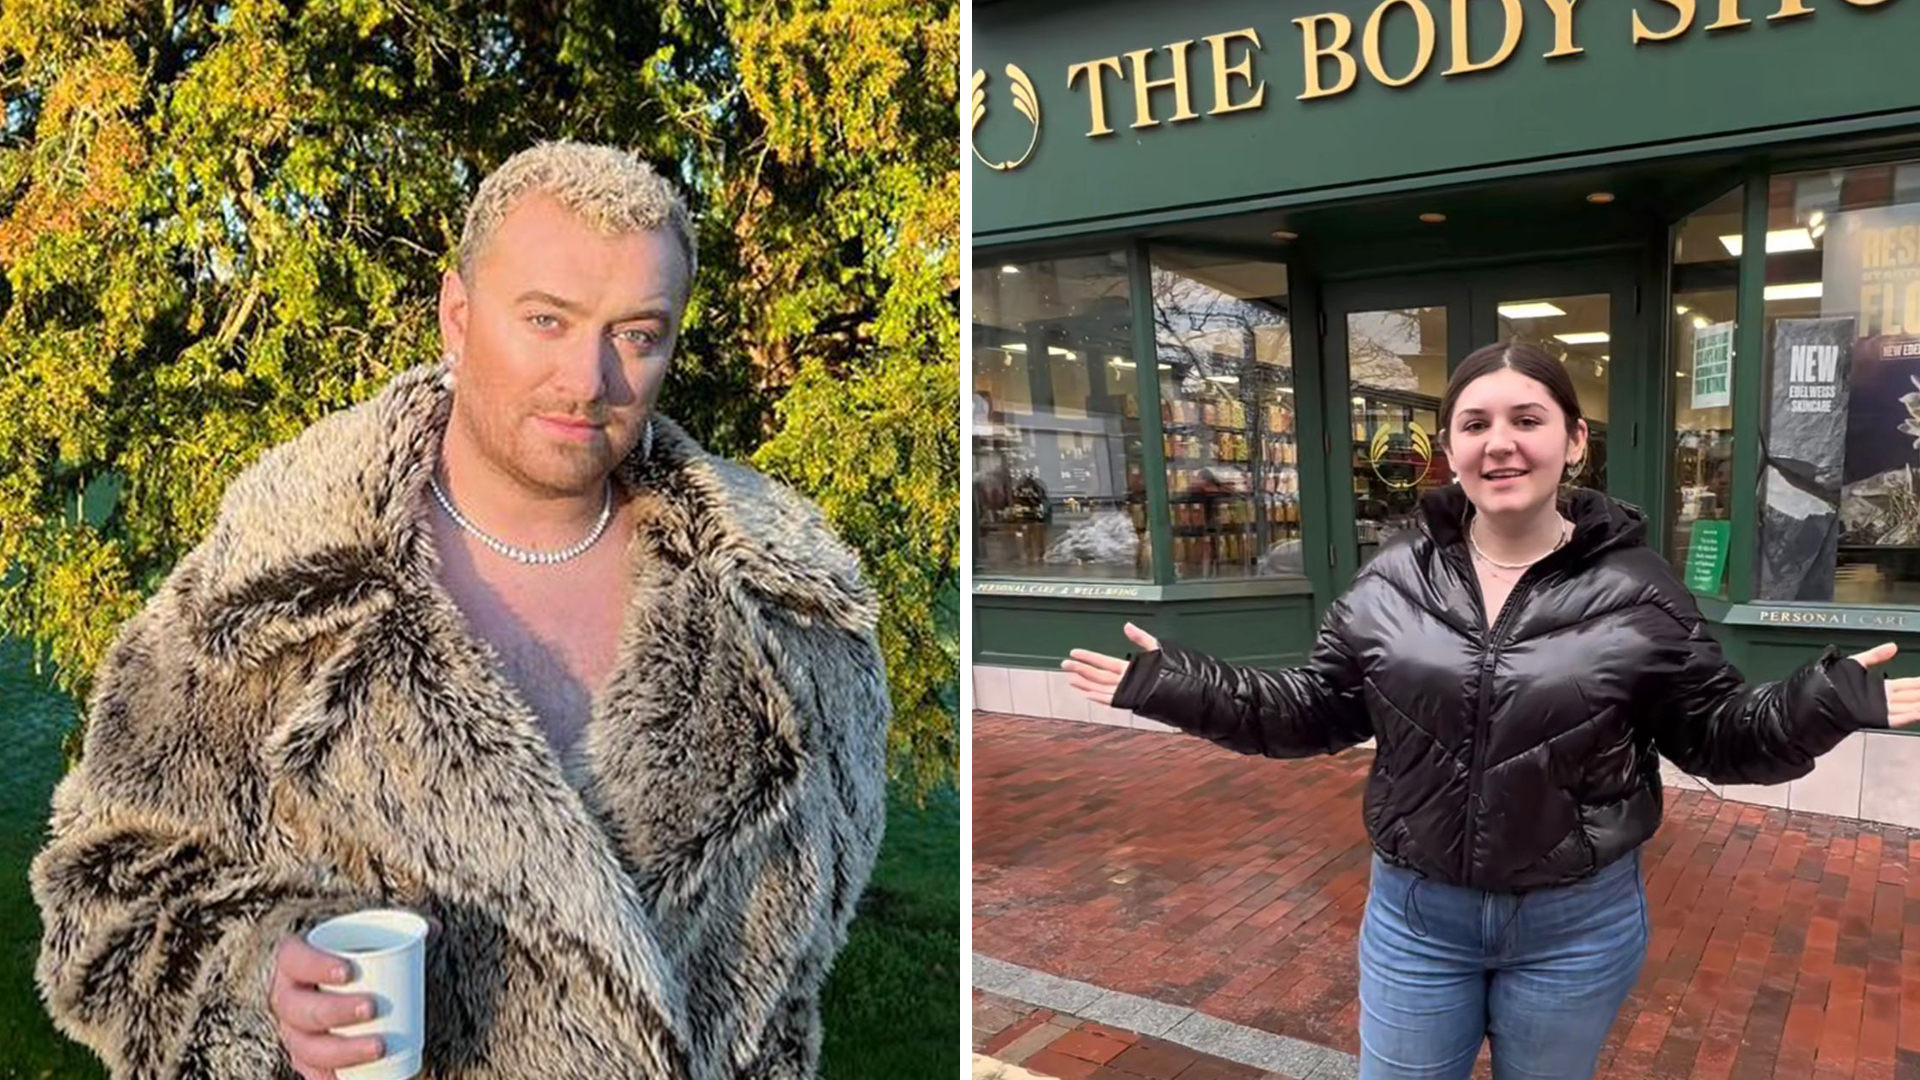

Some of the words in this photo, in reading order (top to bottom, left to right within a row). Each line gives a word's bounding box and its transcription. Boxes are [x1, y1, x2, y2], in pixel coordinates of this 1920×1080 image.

[1067, 27, 1266, 138] THE
[1291, 0, 1584, 100] BODY
[1862, 225, 1920, 268] RES
[1790, 345, 1839, 382] NEW
[1789, 385, 1836, 398] EDELWEISS
[1791, 400, 1832, 412] SKINCARE
[976, 583, 1026, 593] PERSONAL
[1759, 611, 1847, 624] PERSONAL
